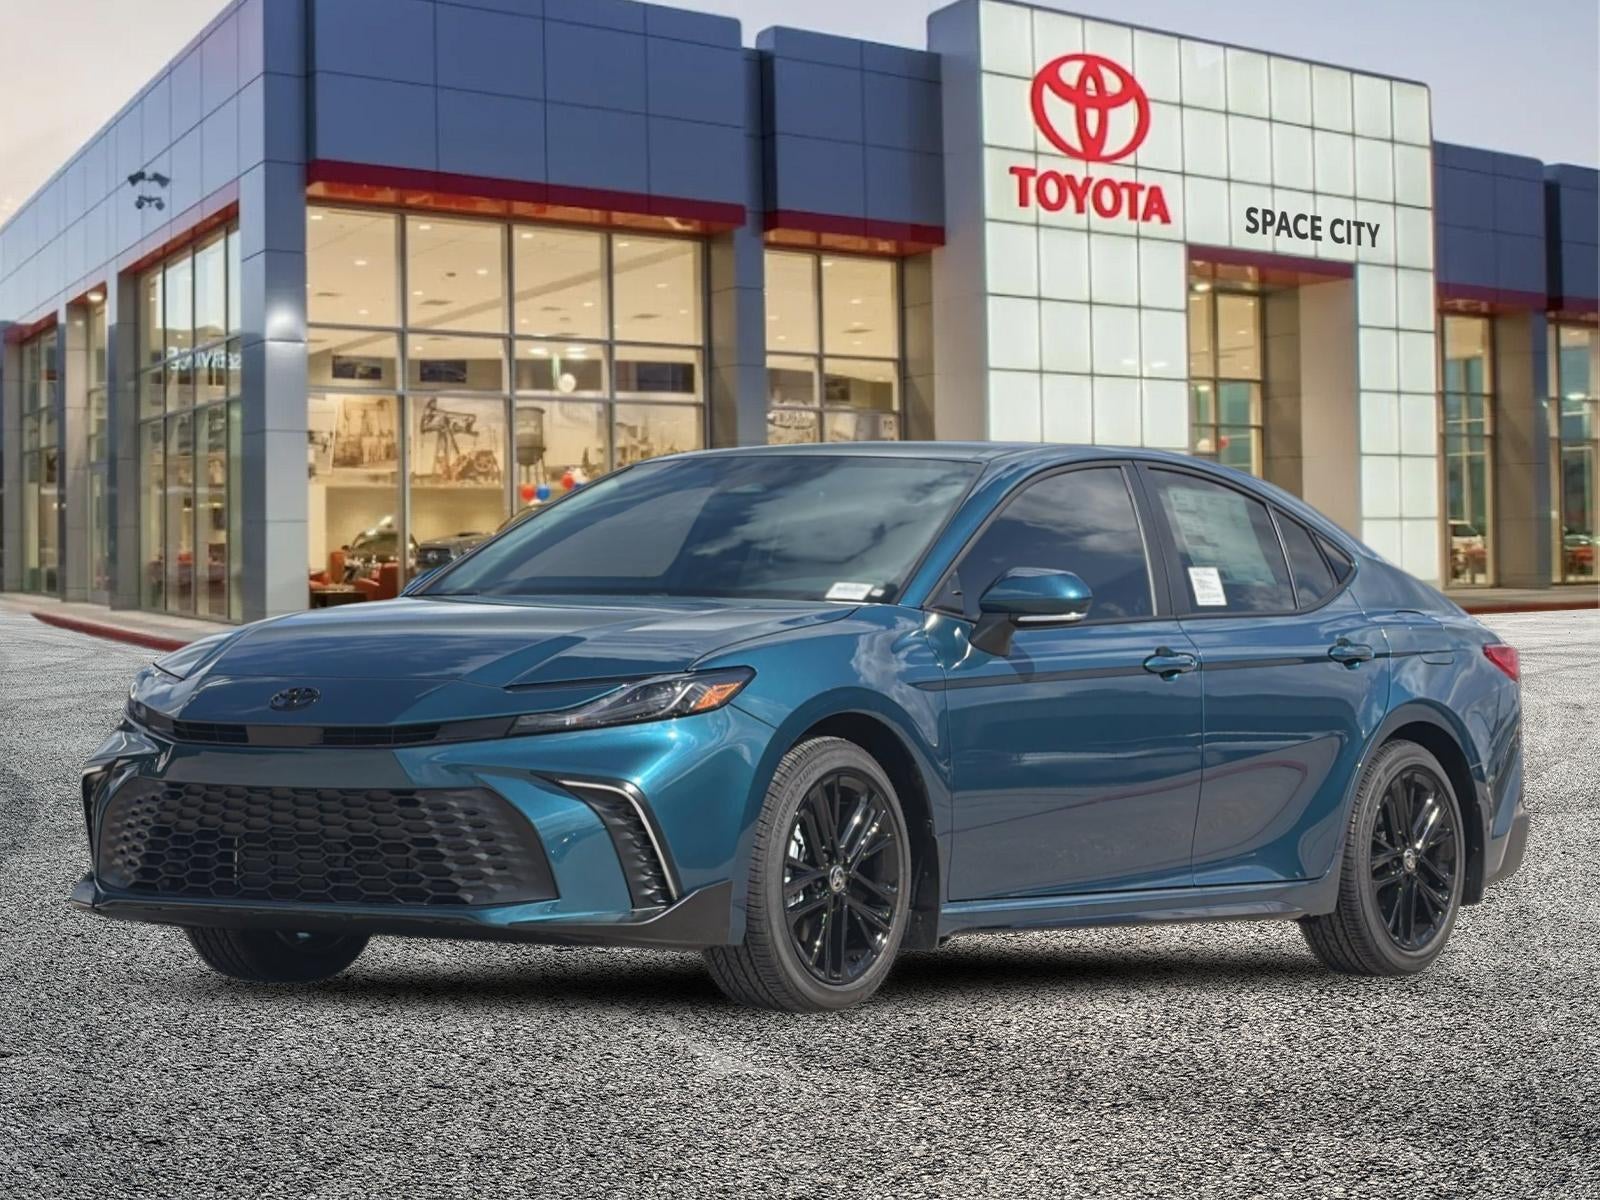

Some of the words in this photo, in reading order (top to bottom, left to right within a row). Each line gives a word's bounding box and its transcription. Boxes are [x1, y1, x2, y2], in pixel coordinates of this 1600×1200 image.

[1009, 166, 1171, 224] TOYOTA
[1245, 206, 1323, 242] SPACE
[1329, 218, 1381, 248] CITY
